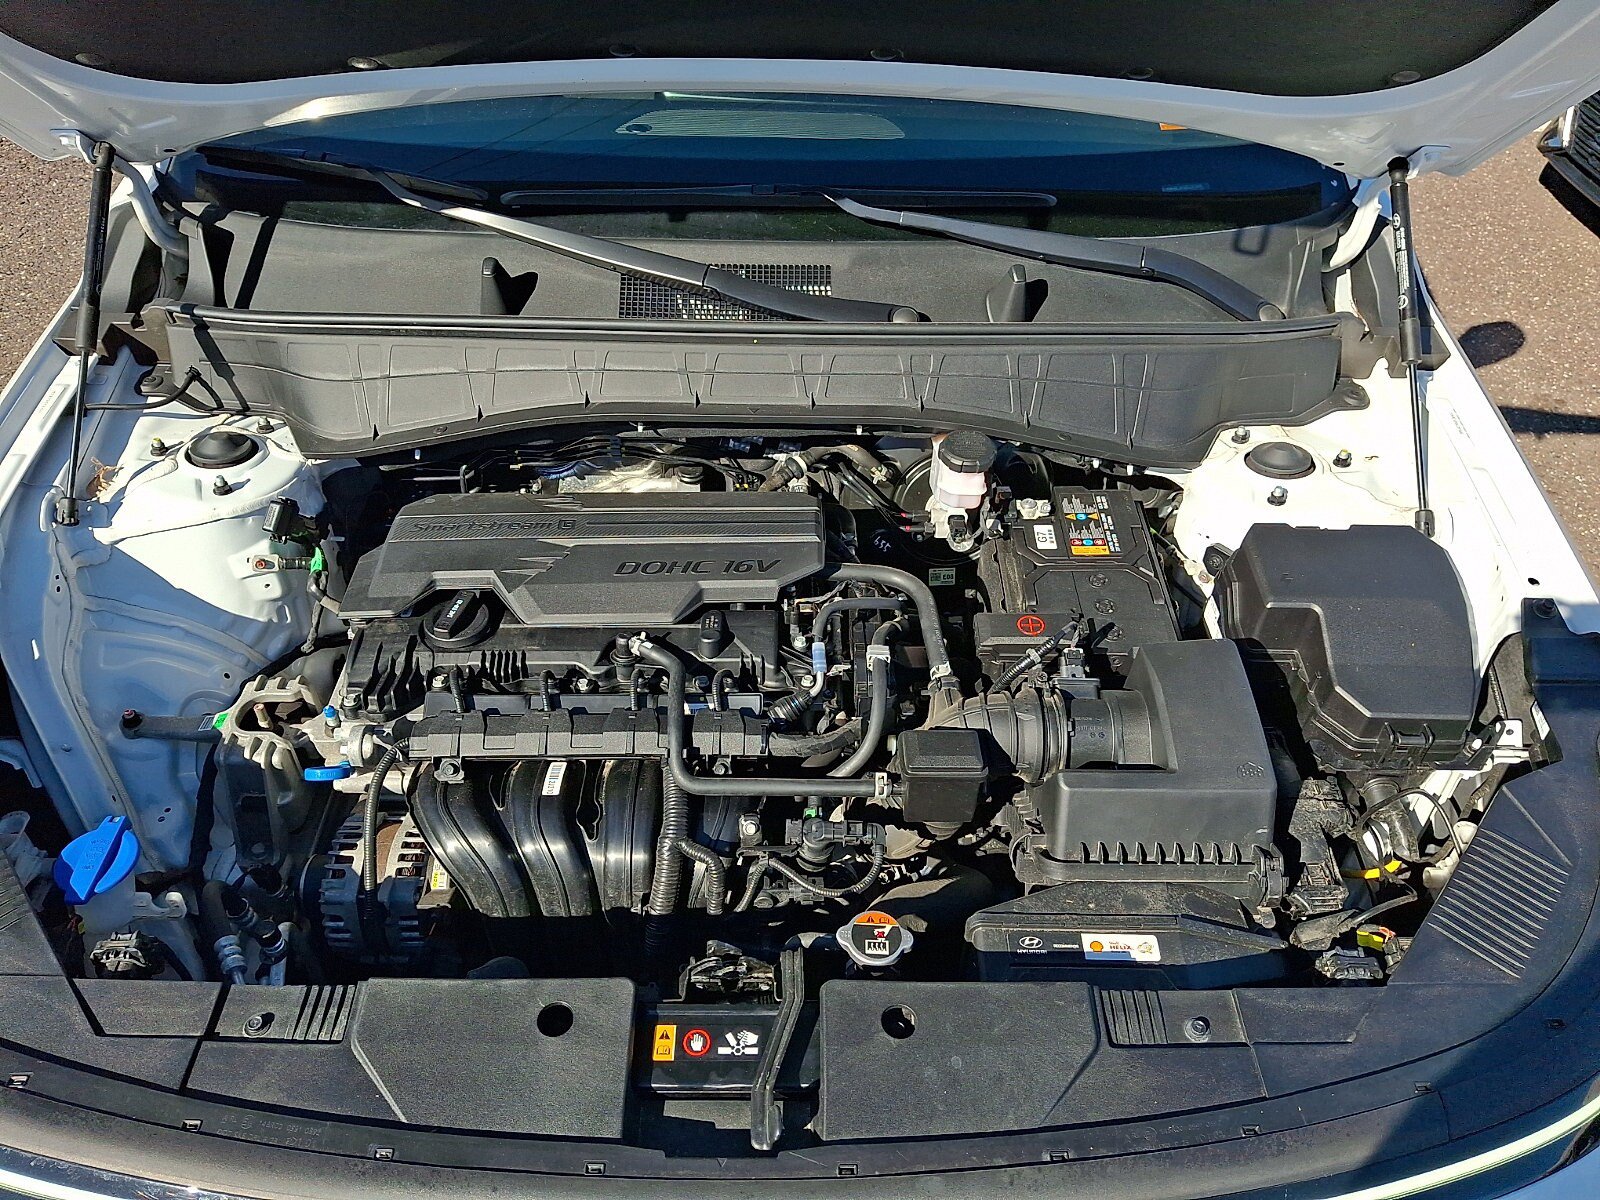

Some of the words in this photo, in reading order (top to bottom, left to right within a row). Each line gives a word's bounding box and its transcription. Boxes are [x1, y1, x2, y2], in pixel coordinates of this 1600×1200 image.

[409, 519, 552, 533] Smartstream
[1036, 531, 1048, 543] G7
[613, 560, 716, 577] DOHC
[722, 559, 782, 575] 16V
